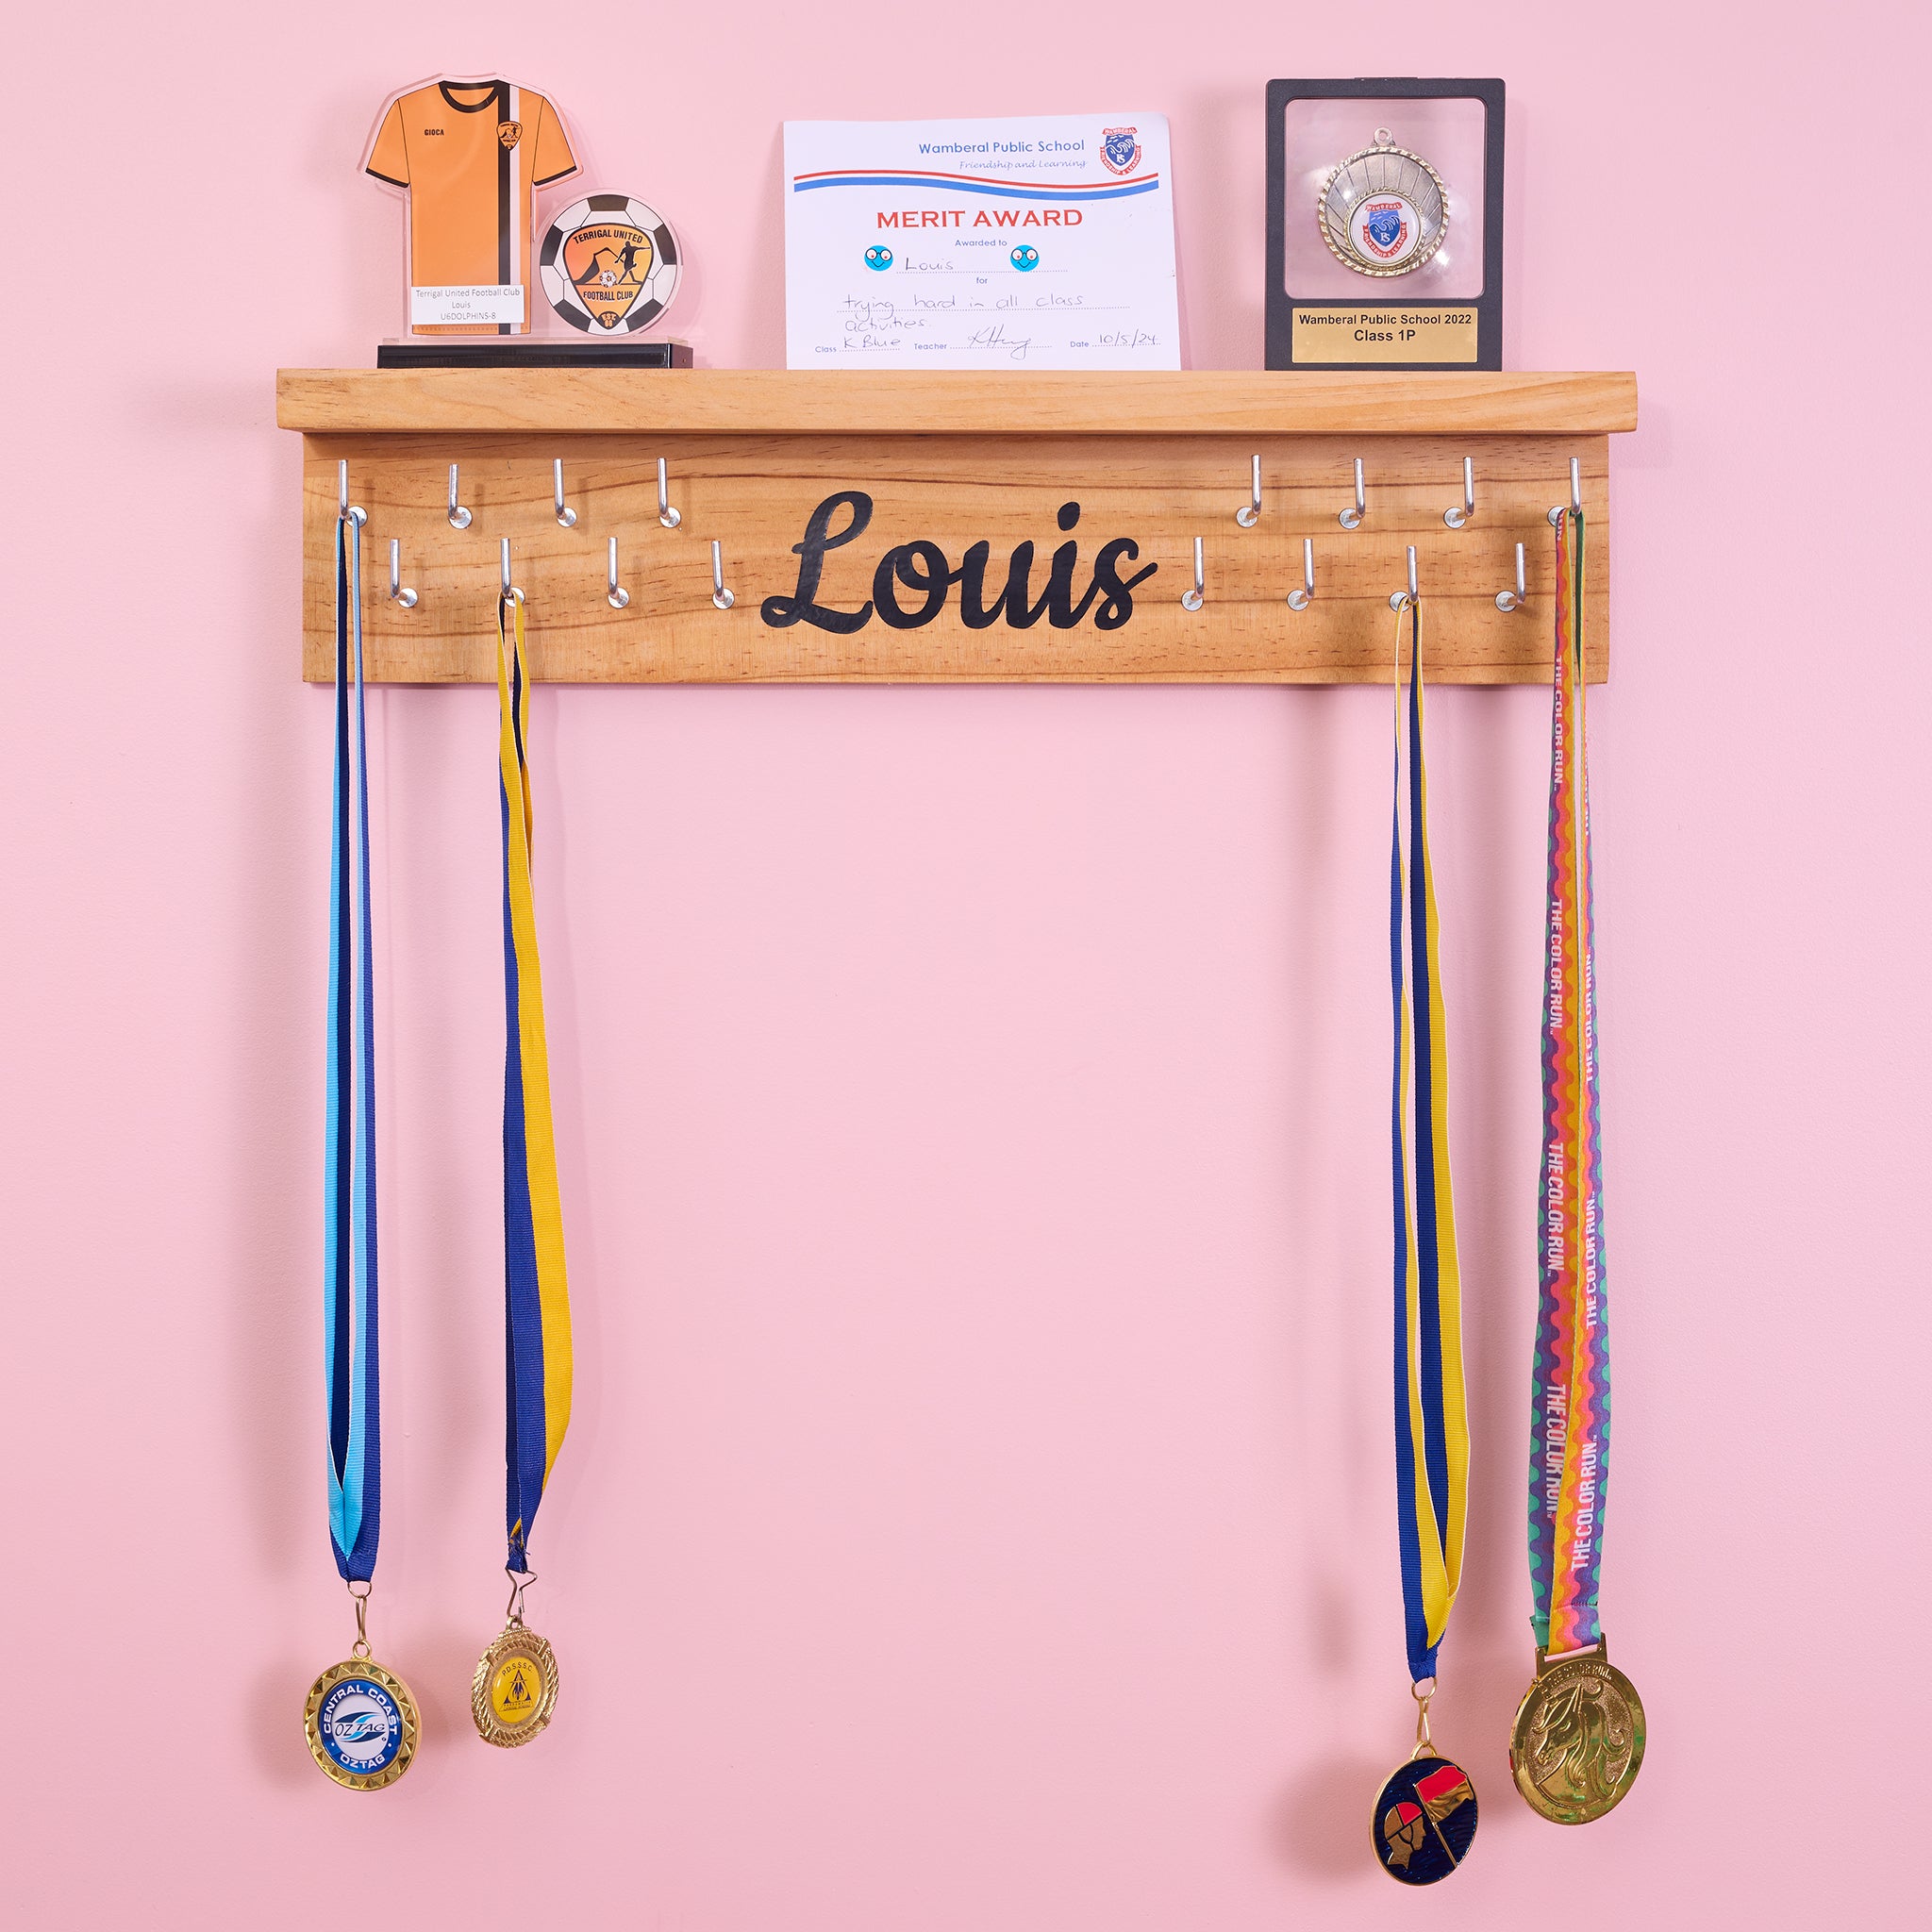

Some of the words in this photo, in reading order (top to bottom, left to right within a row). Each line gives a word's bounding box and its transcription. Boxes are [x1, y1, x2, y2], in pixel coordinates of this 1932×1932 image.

[919, 142, 989, 154] Wamberal
[993, 142, 1033, 153] Public
[1038, 140, 1085, 152] School
[959, 159, 1013, 171] Friendship
[1015, 160, 1037, 169] and
[1039, 158, 1087, 169] Learning
[877, 210, 966, 228] MERIT
[973, 209, 1083, 227] AWARD
[574, 229, 611, 244] TERRIGAL
[613, 229, 643, 243] UNITED
[905, 258, 954, 271] Louis
[416, 290, 442, 299] Terrigal
[445, 289, 469, 297] United
[472, 288, 502, 297] Football
[504, 288, 521, 296] Club
[583, 291, 615, 301] FOOTBALL
[616, 291, 633, 300] CLUB
[842, 294, 894, 322] trying
[914, 294, 956, 308] hard
[996, 294, 1018, 309] all
[1036, 293, 1084, 308] class
[441, 312, 496, 321] U6DOLPHINS-8
[1299, 314, 1357, 325] Wamberal
[1360, 314, 1397, 325] Public
[1400, 314, 1441, 325] School
[1444, 314, 1472, 325] 2022
[844, 337, 857, 348] K
[863, 335, 901, 348] Blue
[1099, 329, 1156, 348] 10/5/24
[1354, 329, 1393, 341] Class
[1398, 330, 1416, 341] 1P
[760, 491, 1158, 634] Louis
[1555, 689, 1563, 746] COLOR
[1551, 899, 1562, 930] THE
[1550, 932, 1562, 990] COLOR
[1548, 1142, 1563, 1173] THE
[1548, 1174, 1564, 1231] COLOR
[1586, 1232, 1596, 1294] COLOR
[1586, 1296, 1597, 1330] THE
[1546, 1384, 1567, 1416] THE
[1546, 1417, 1567, 1473] COLOR
[1576, 1478, 1596, 1537] COLOR
[1571, 1538, 1592, 1573] THE
[324, 1685, 364, 1734] CENTRAL
[368, 1688, 397, 1736] COAST
[341, 1753, 386, 1770] OZTAG
